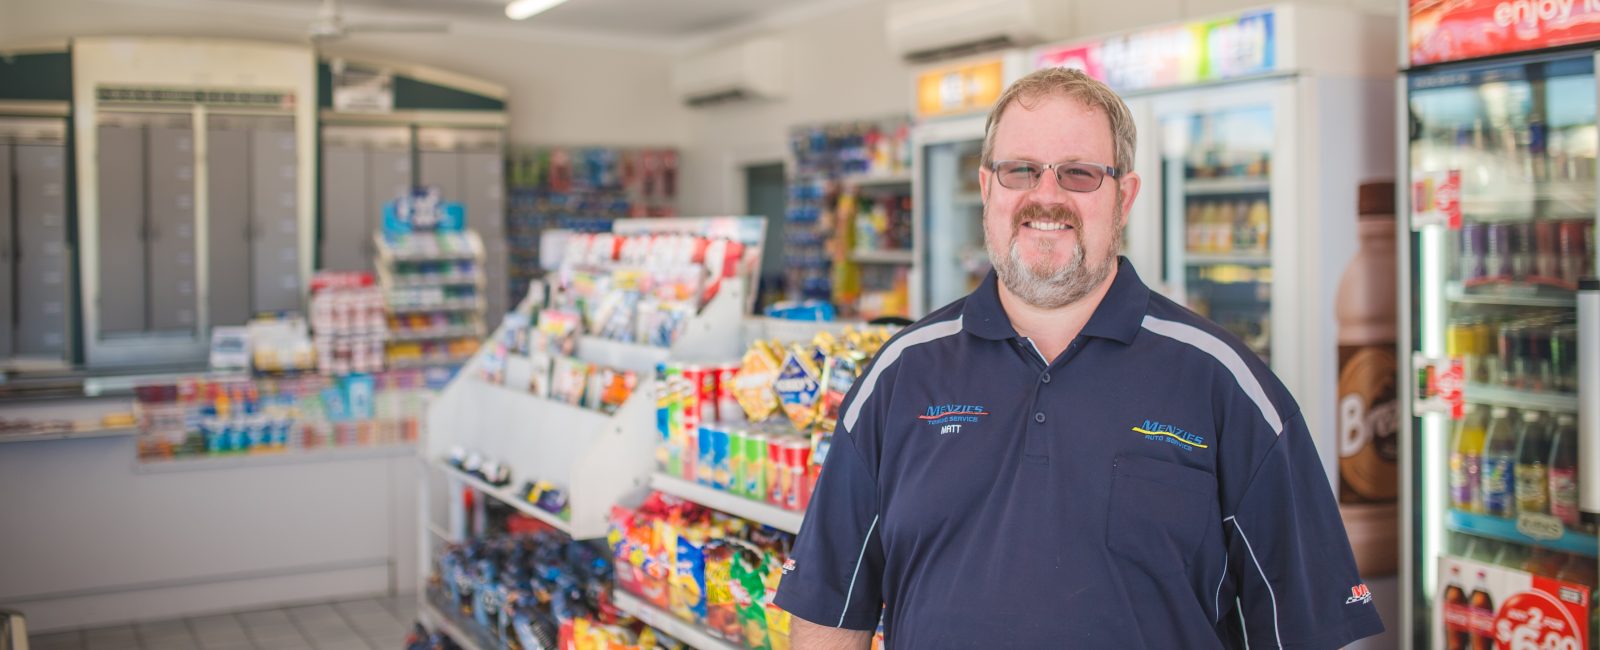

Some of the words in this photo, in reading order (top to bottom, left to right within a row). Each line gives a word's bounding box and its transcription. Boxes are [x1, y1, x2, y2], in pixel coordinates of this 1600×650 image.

[1493, 0, 1573, 40] enjoy
[926, 404, 984, 416] MENZIES
[948, 415, 978, 423] SERVICE
[940, 424, 962, 435] MATT
[1141, 419, 1204, 445] MENZIES
[1144, 434, 1163, 442] AUTO
[1165, 436, 1193, 452] SERVICE
[1527, 607, 1543, 628] 2
